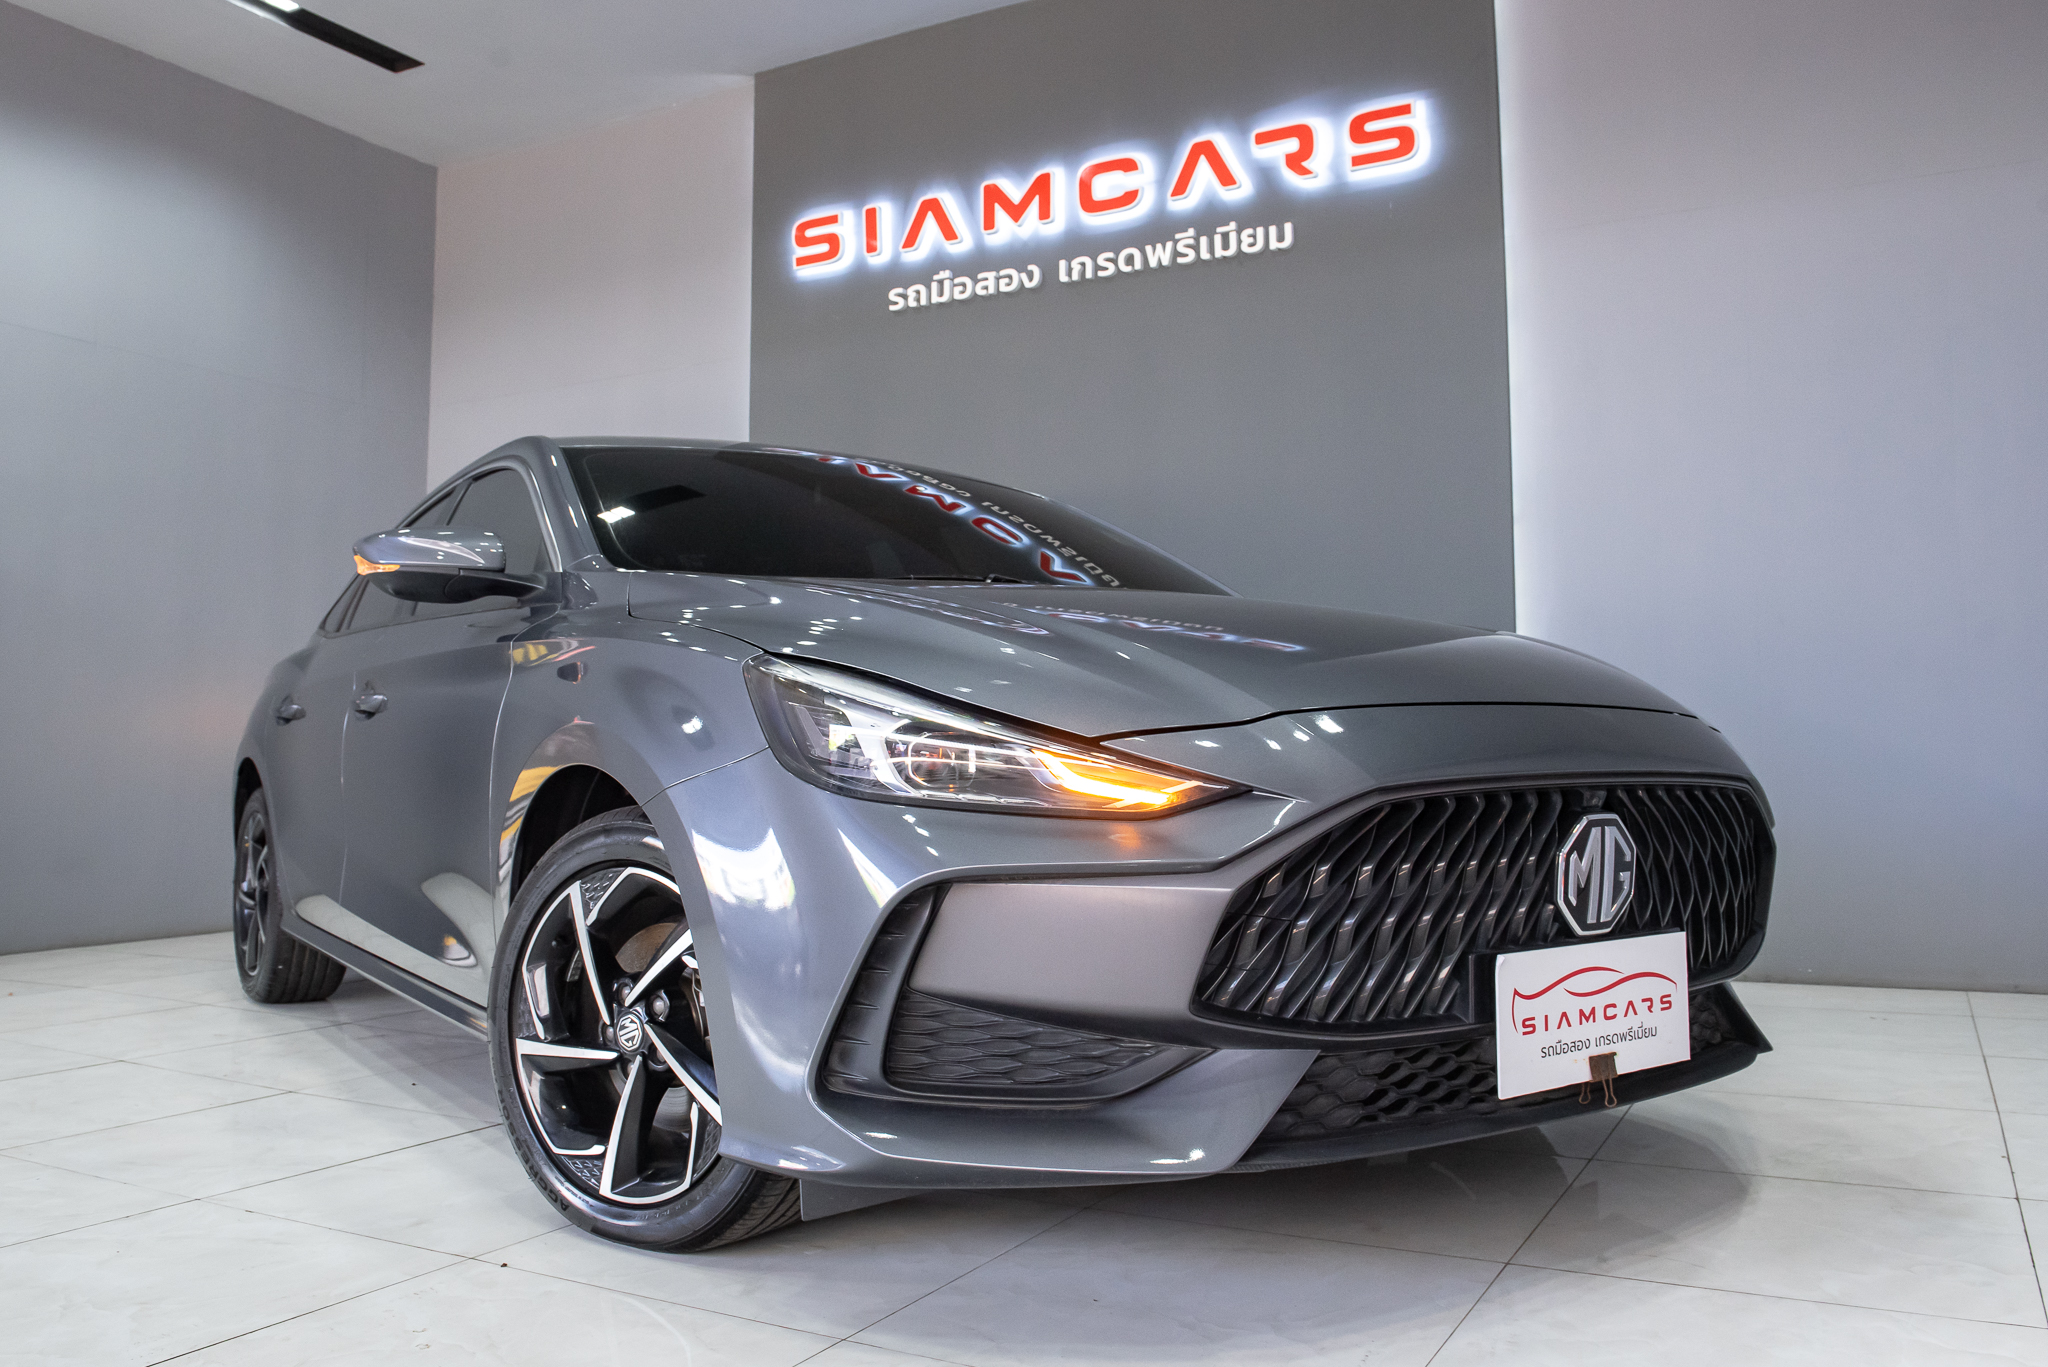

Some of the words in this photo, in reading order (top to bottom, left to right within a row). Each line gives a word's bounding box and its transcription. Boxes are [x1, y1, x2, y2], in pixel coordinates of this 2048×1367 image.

[792, 98, 1426, 271] SIAMCARS
[887, 268, 1043, 312] รถมือสอง
[1057, 220, 1295, 284] เกรดพรีเมียม
[1568, 825, 1632, 925] MG
[618, 1016, 640, 1048] MG
[1521, 993, 1673, 1036] SIAMCARS
[1540, 1038, 1591, 1059] รถมือสอง
[1594, 1020, 1658, 1048] เกรดพรีเมี่ยม
[497, 1089, 570, 1213] AGGRESSOR
